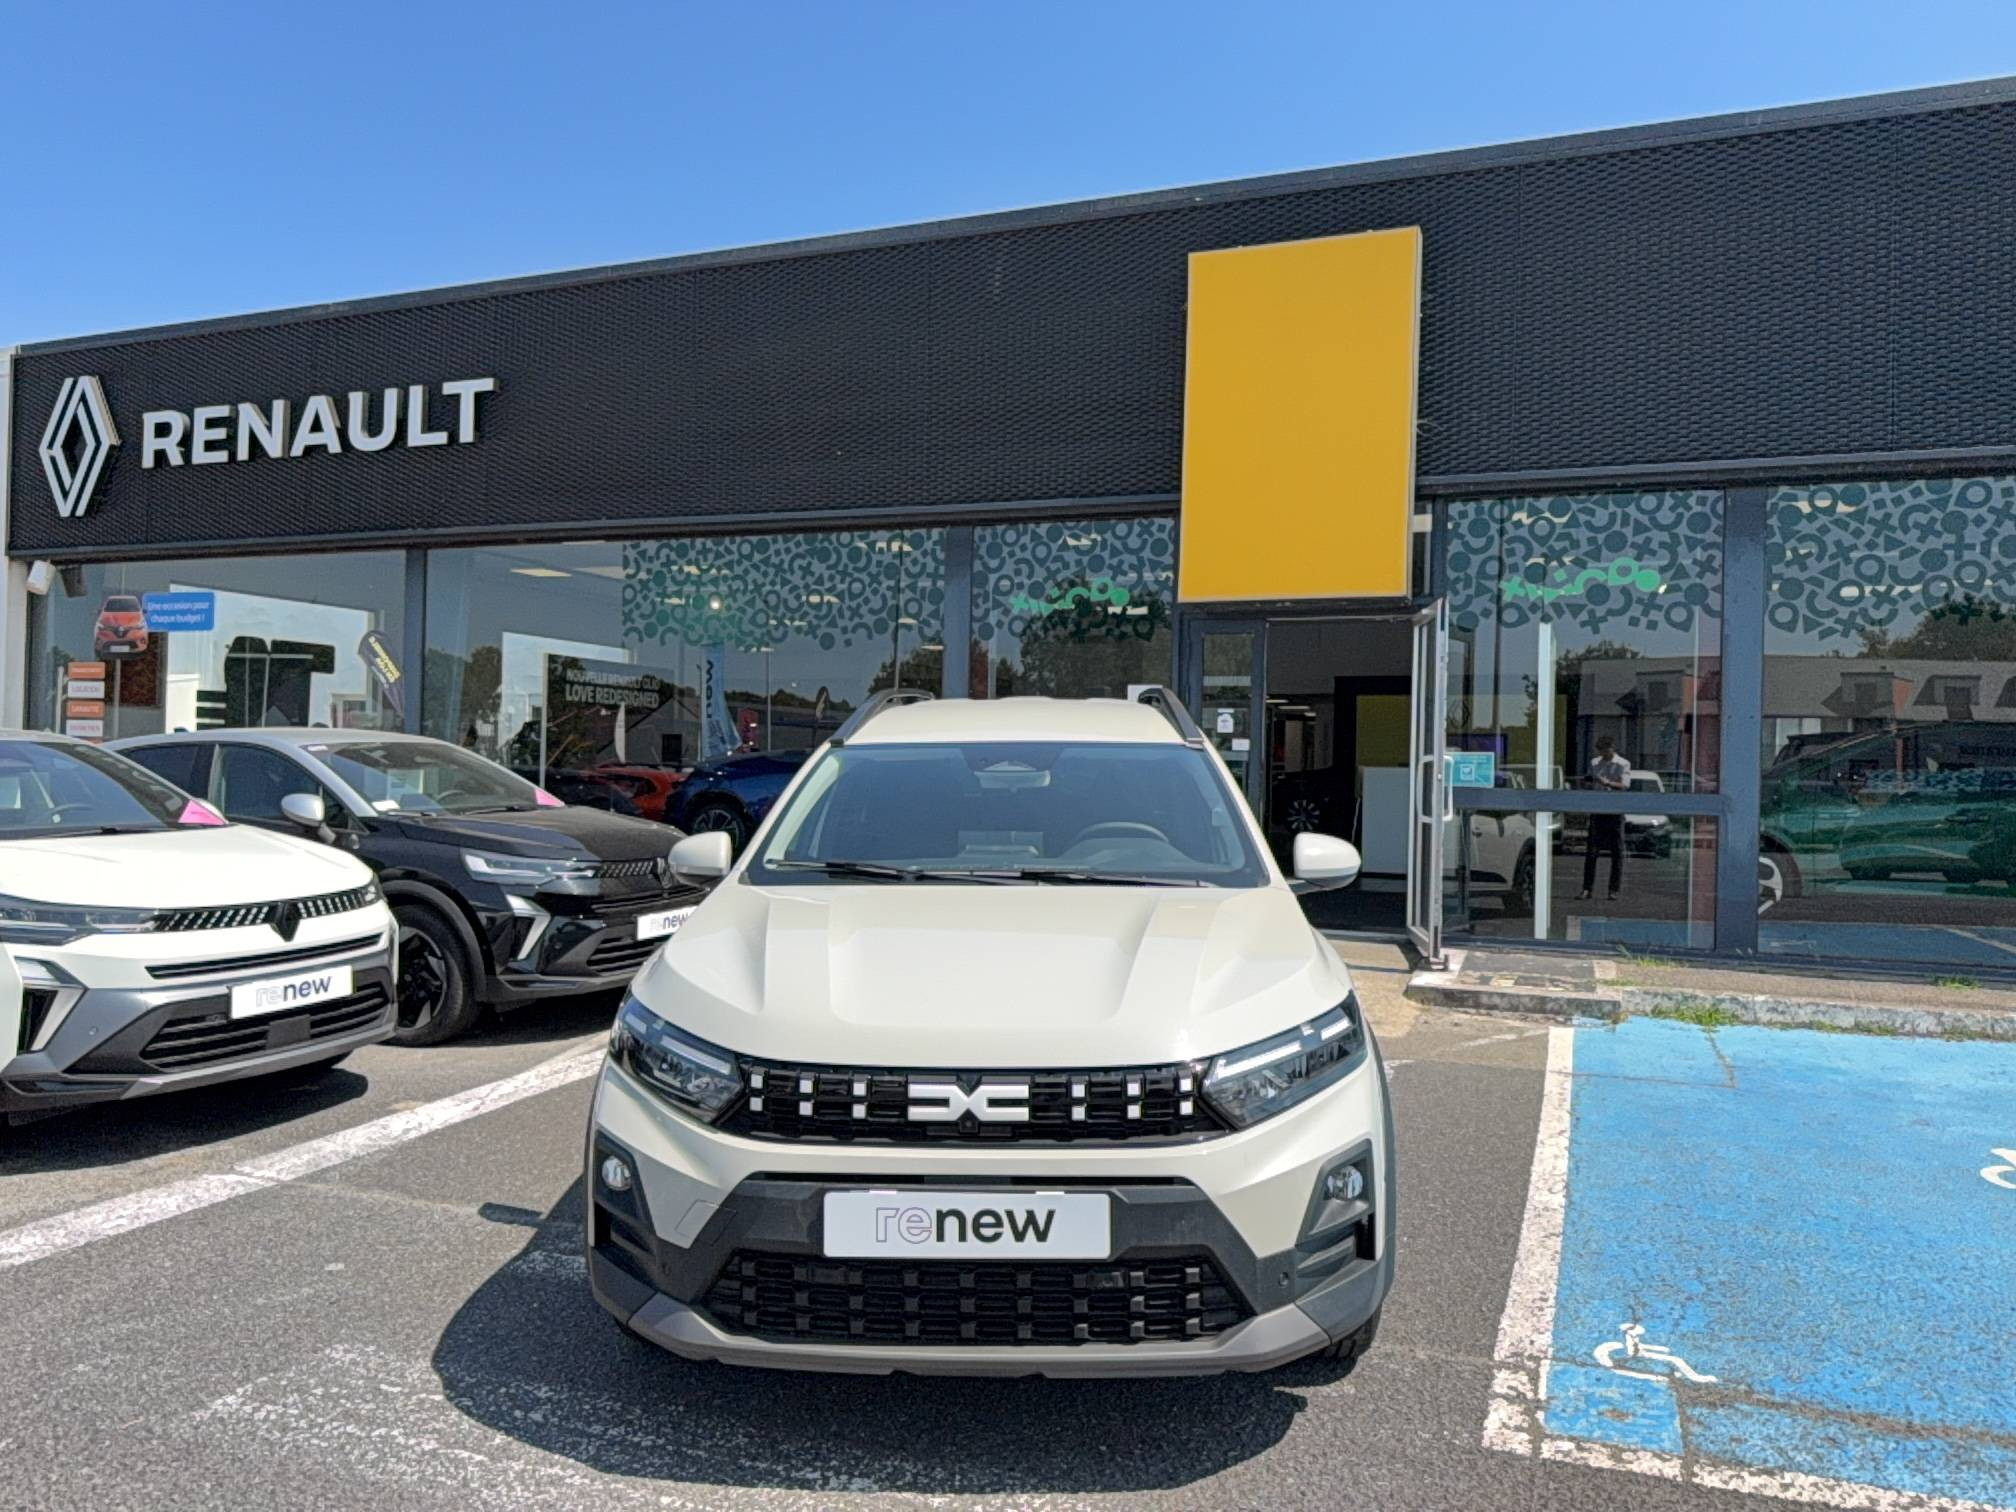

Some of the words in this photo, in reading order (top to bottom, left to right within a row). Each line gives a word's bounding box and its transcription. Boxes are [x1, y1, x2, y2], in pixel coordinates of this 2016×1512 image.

[142, 378, 497, 469] RENAULT
[565, 683, 594, 703] LOVE
[595, 686, 660, 709] REDESIGNED
[256, 975, 332, 1007] renew
[875, 1206, 1057, 1244] renew
